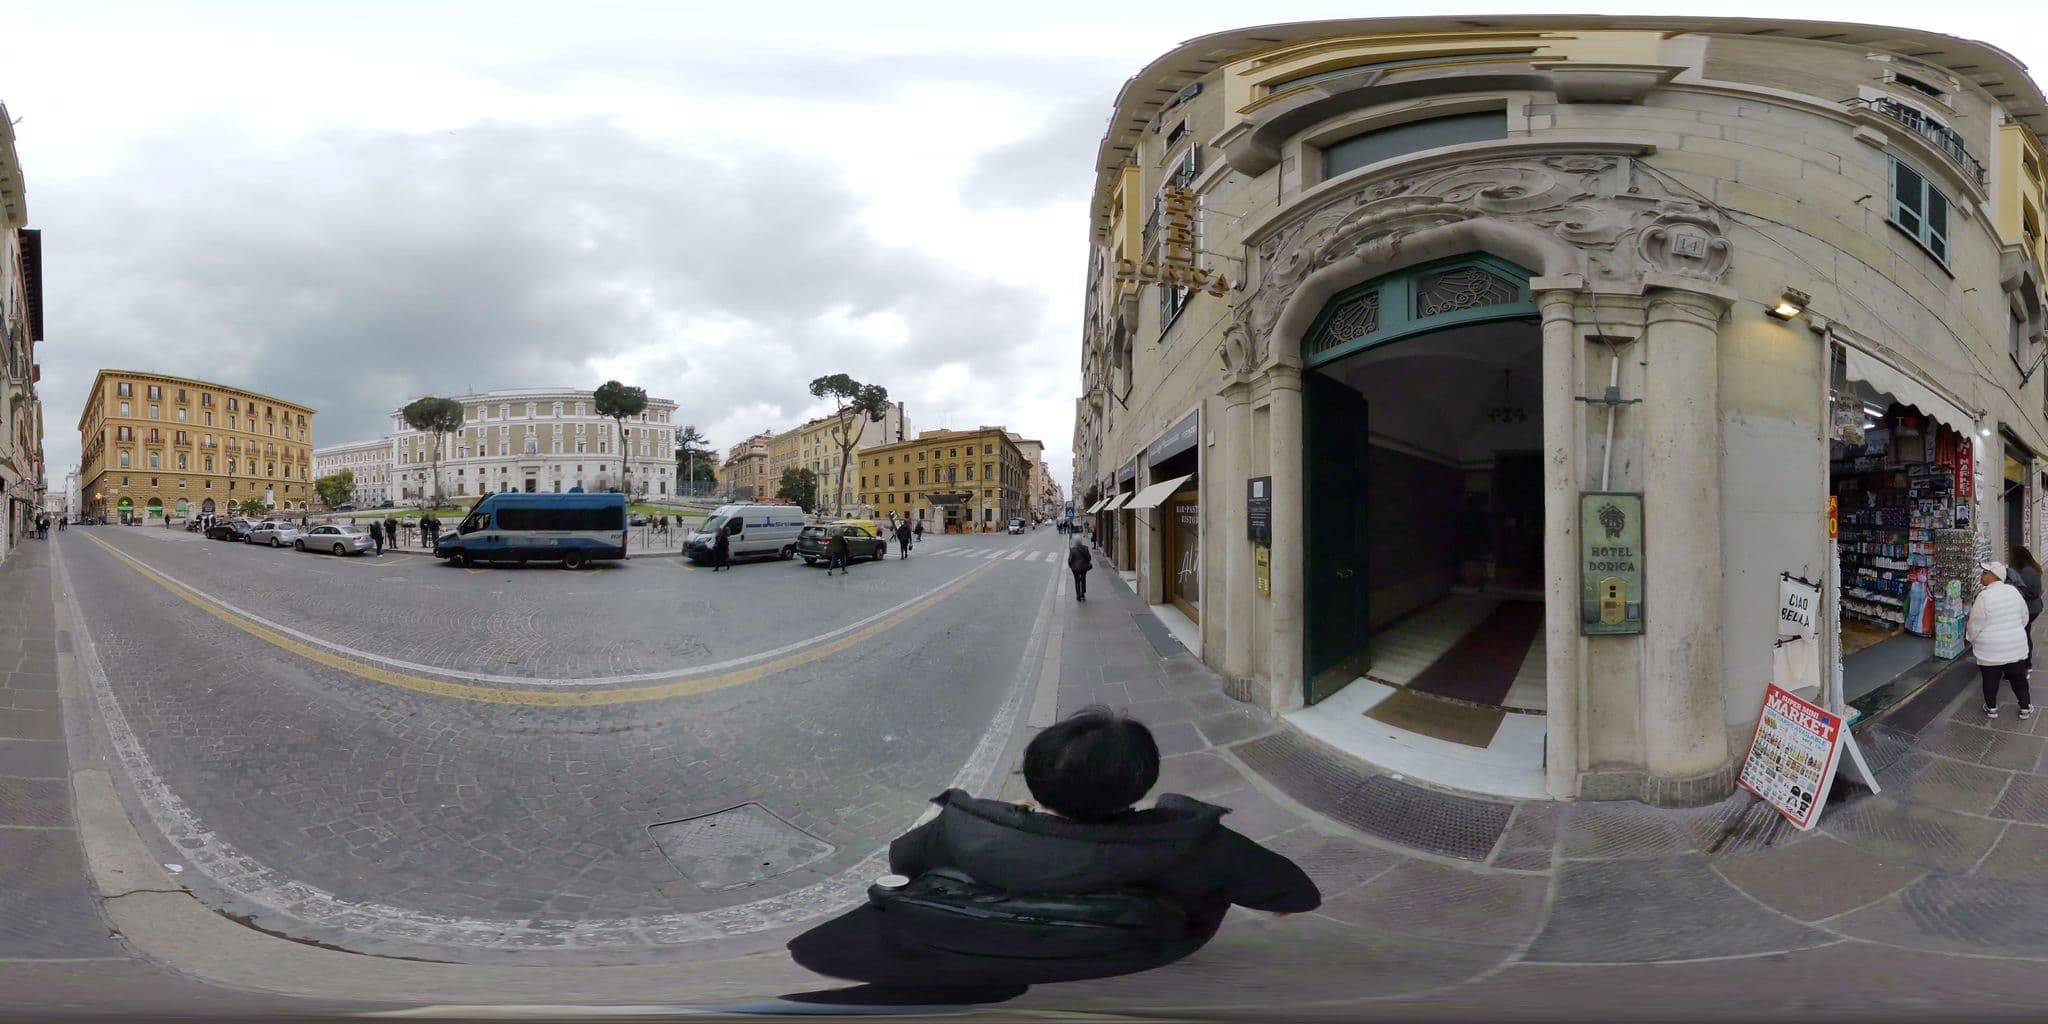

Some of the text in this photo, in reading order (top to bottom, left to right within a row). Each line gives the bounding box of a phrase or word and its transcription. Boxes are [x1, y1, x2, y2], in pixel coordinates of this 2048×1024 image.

[1165, 184, 1194, 262] HOTEL
[1682, 238, 1699, 251] 14
[1118, 259, 1231, 292] DORICA
[1591, 547, 1633, 557] HOTEL
[1589, 562, 1635, 572] DORICA
[1789, 593, 1809, 611] CIAO
[1781, 607, 1810, 628] BELLA
[1767, 694, 1834, 740] MARKET
[1781, 695, 1820, 720] SUPER MINI
